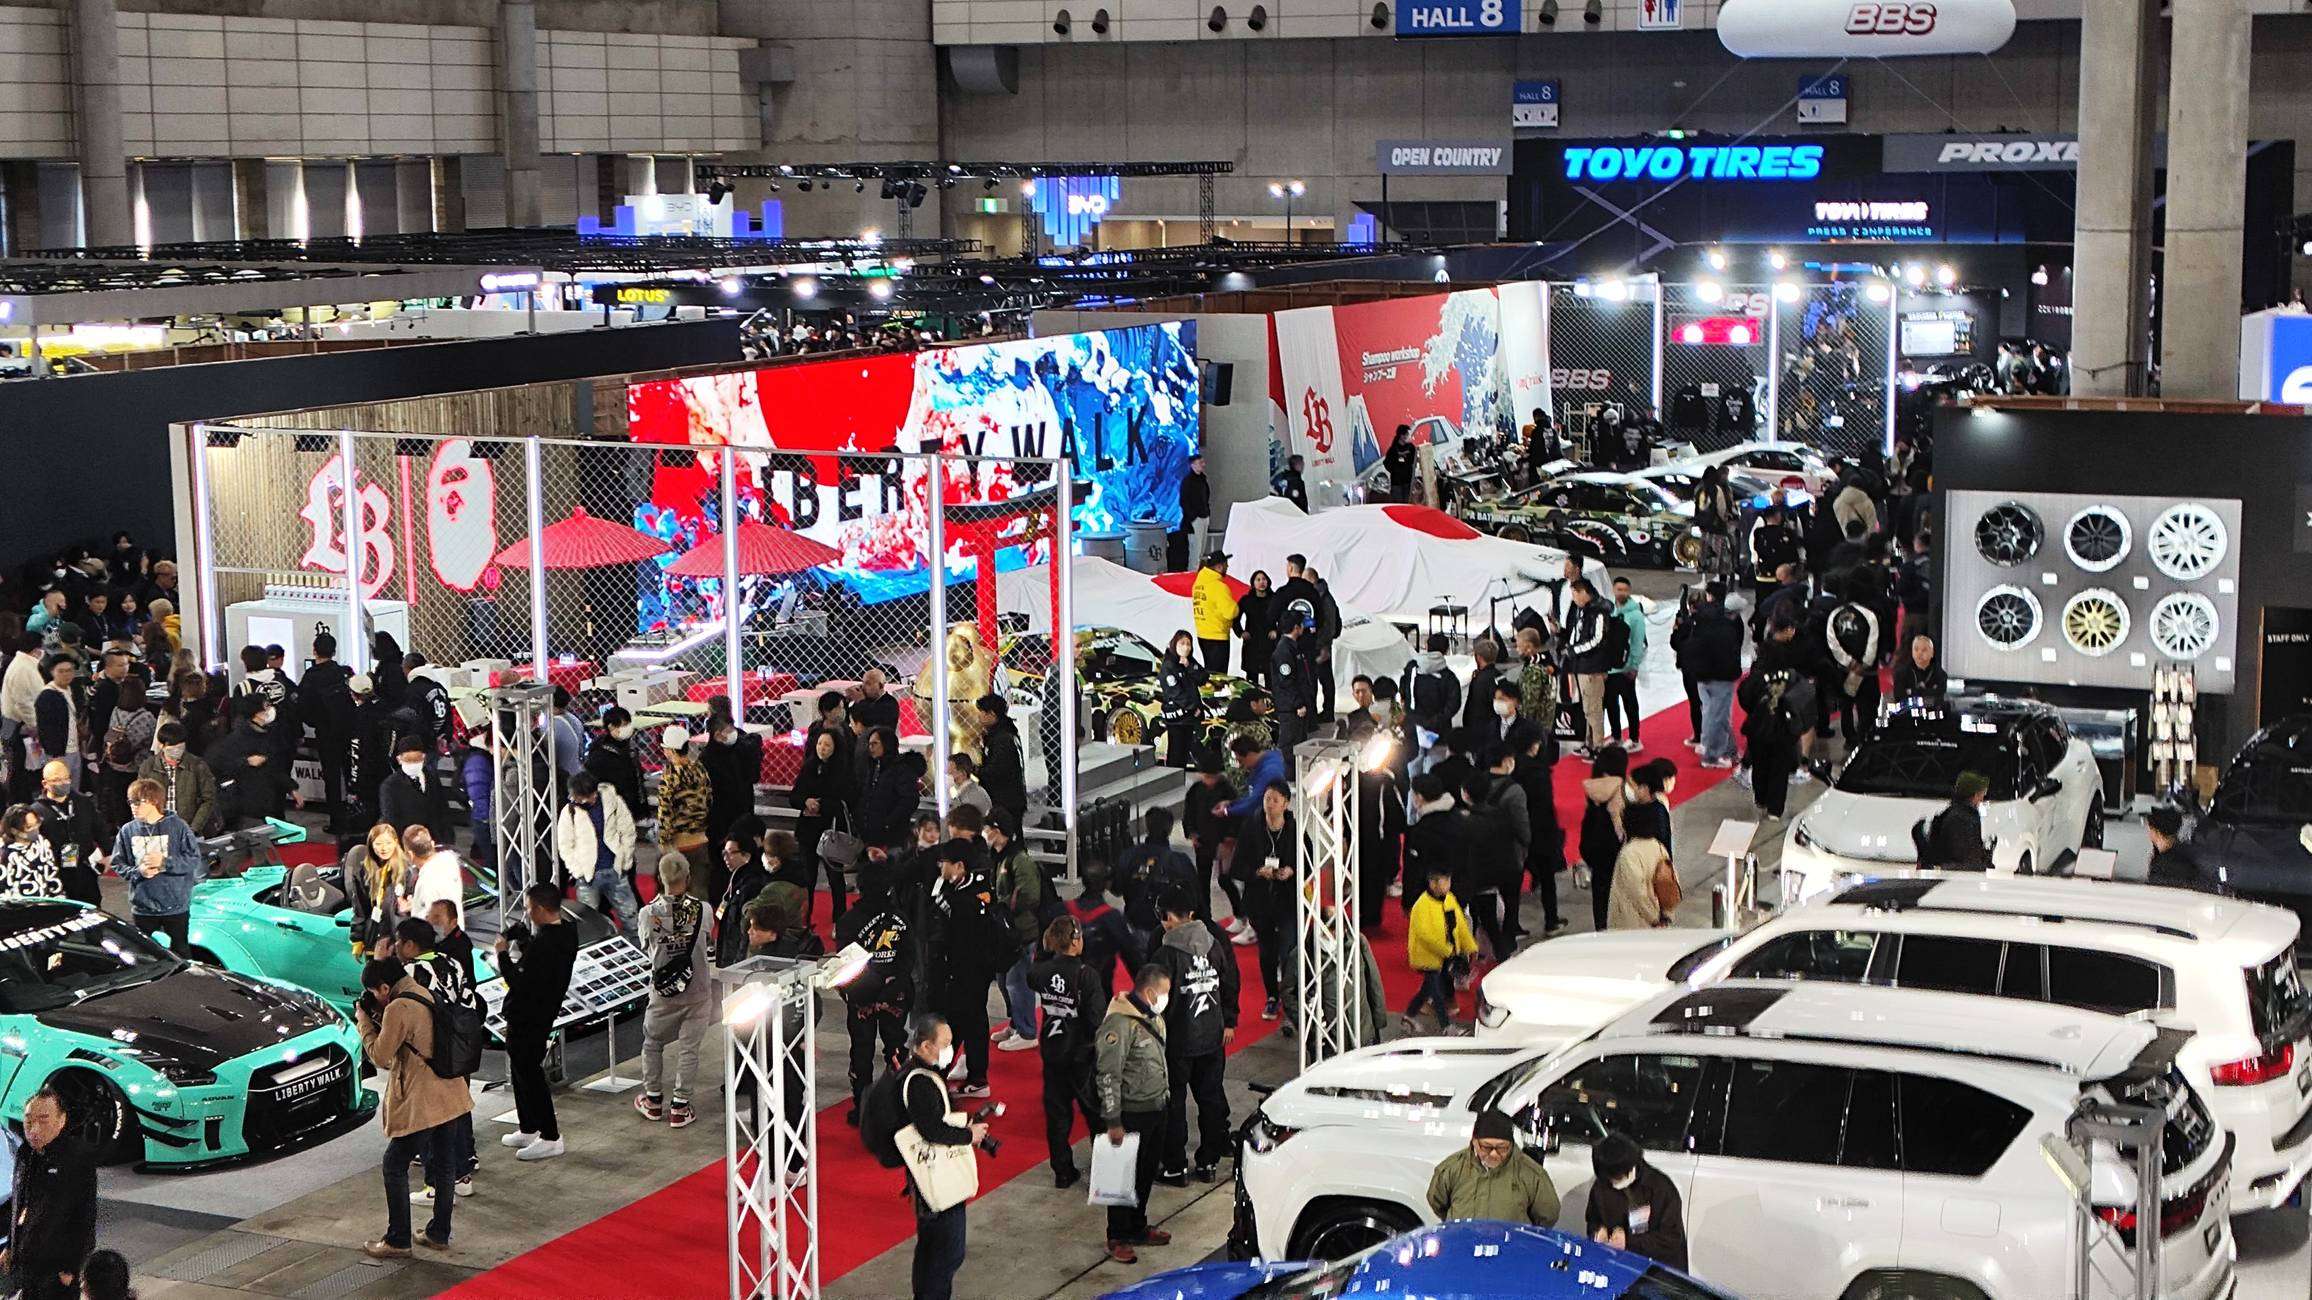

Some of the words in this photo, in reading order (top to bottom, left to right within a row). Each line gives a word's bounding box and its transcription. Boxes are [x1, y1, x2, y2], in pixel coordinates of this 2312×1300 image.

[1411, 7, 1474, 28] HALL
[1480, 0, 1504, 27] 8
[1844, 3, 1937, 35] BBS
[1520, 91, 1539, 100] HALL
[1541, 85, 1552, 100] 8
[1829, 80, 1840, 95] 8
[1391, 148, 1430, 166] OPEN
[1433, 147, 1502, 166] COUNTRY
[1564, 147, 1684, 178] TOYO
[1688, 146, 1824, 178] TIRES
[1807, 227, 1847, 236] PRESS
[1852, 226, 1932, 237] CONFERENCE
[617, 288, 666, 303] LOTUS
[1551, 368, 1613, 390] BBS
[1010, 405, 1149, 486] WALK
[2267, 635, 2290, 643] STAFF
[2291, 634, 2311, 643] ONLY
[275, 1078, 316, 1101] LIBERTY
